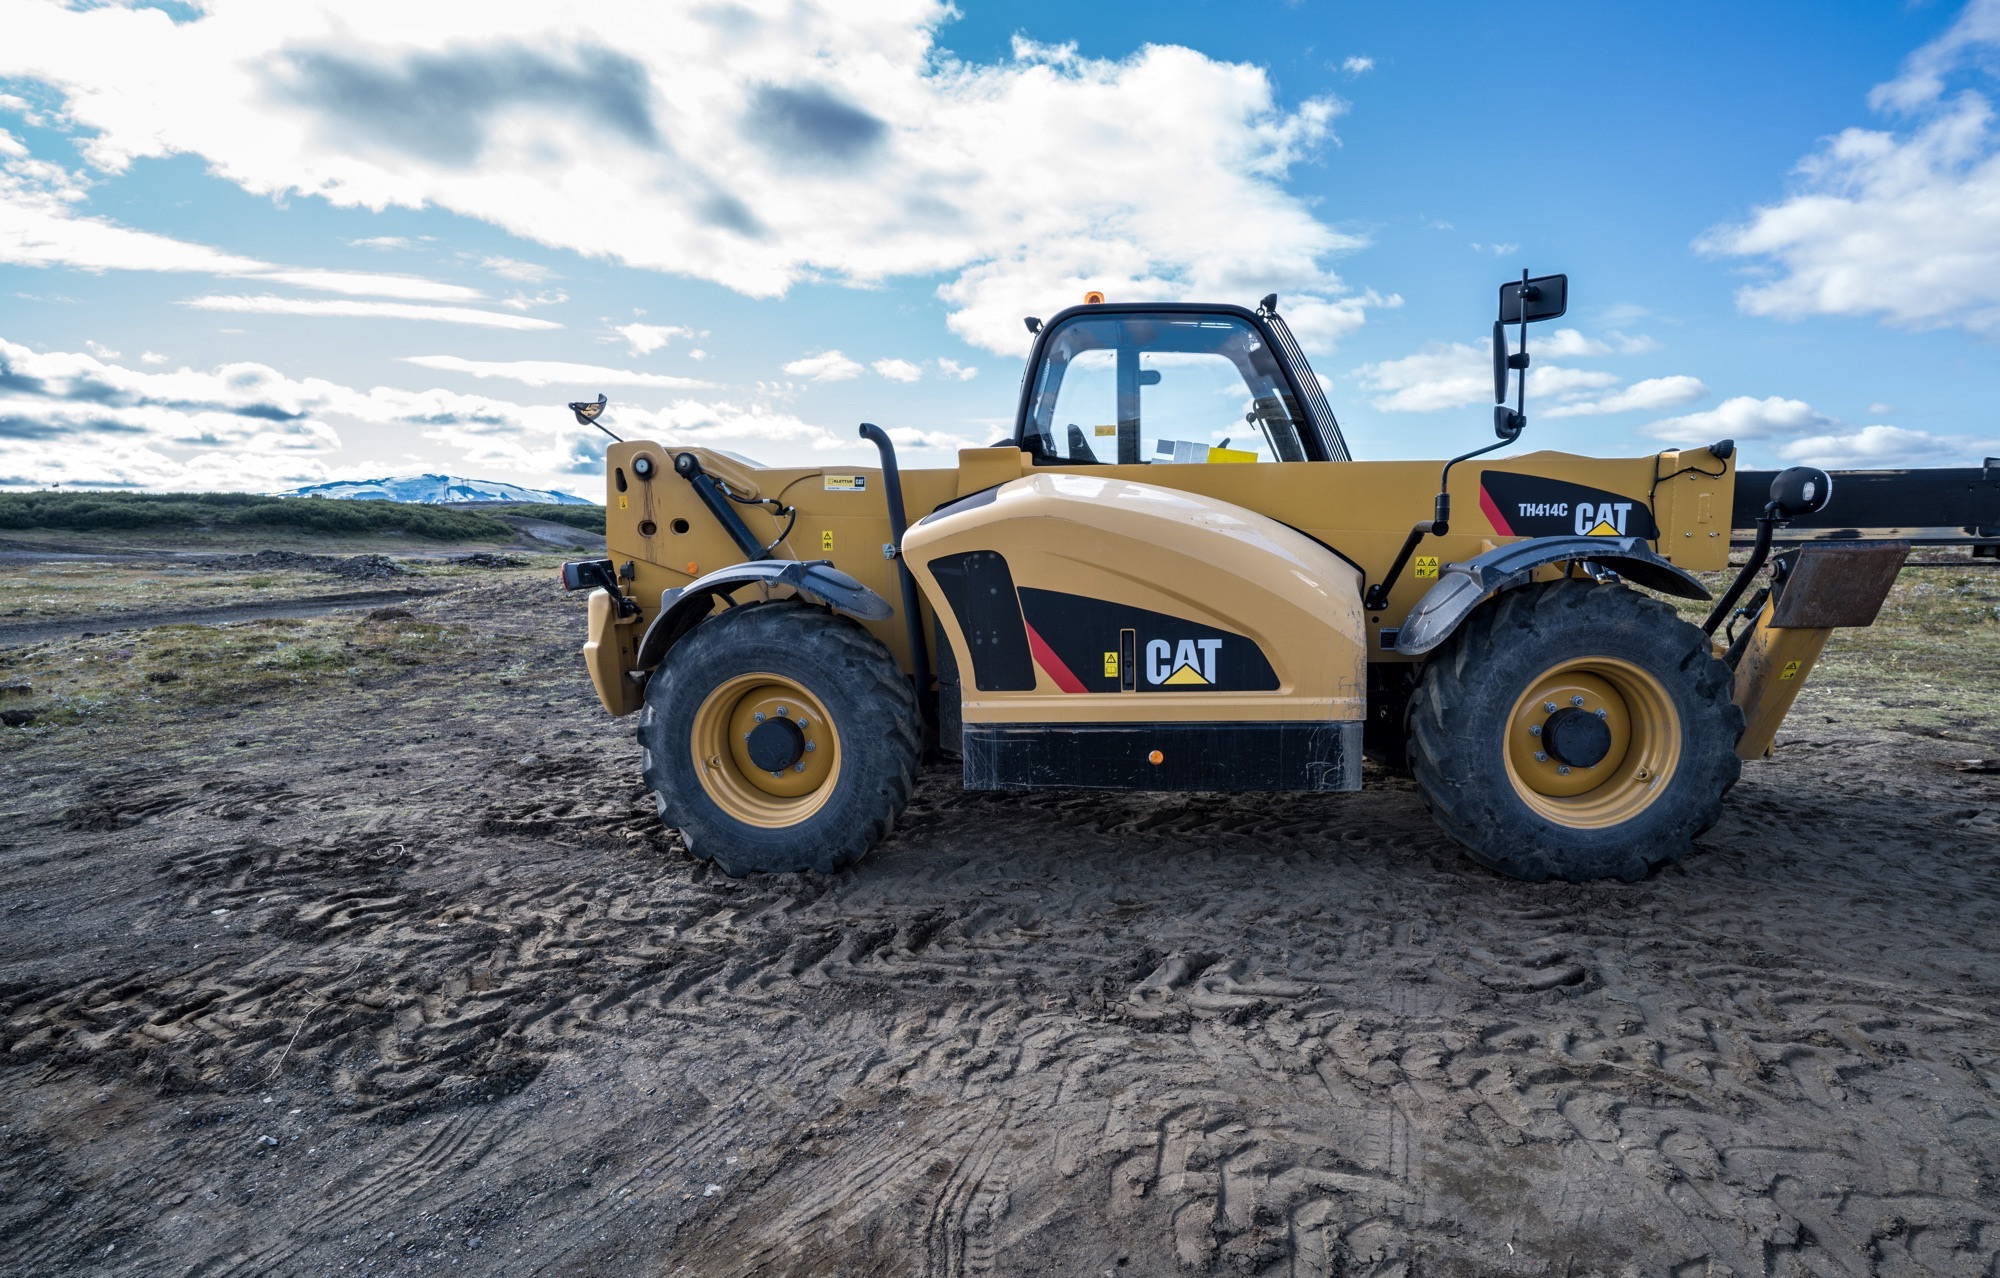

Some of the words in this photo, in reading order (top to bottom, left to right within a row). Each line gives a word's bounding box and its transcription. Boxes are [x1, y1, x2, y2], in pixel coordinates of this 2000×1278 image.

[1518, 503, 1568, 517] TH414C
[1574, 502, 1632, 536] CAT
[1146, 638, 1223, 685] CAT
